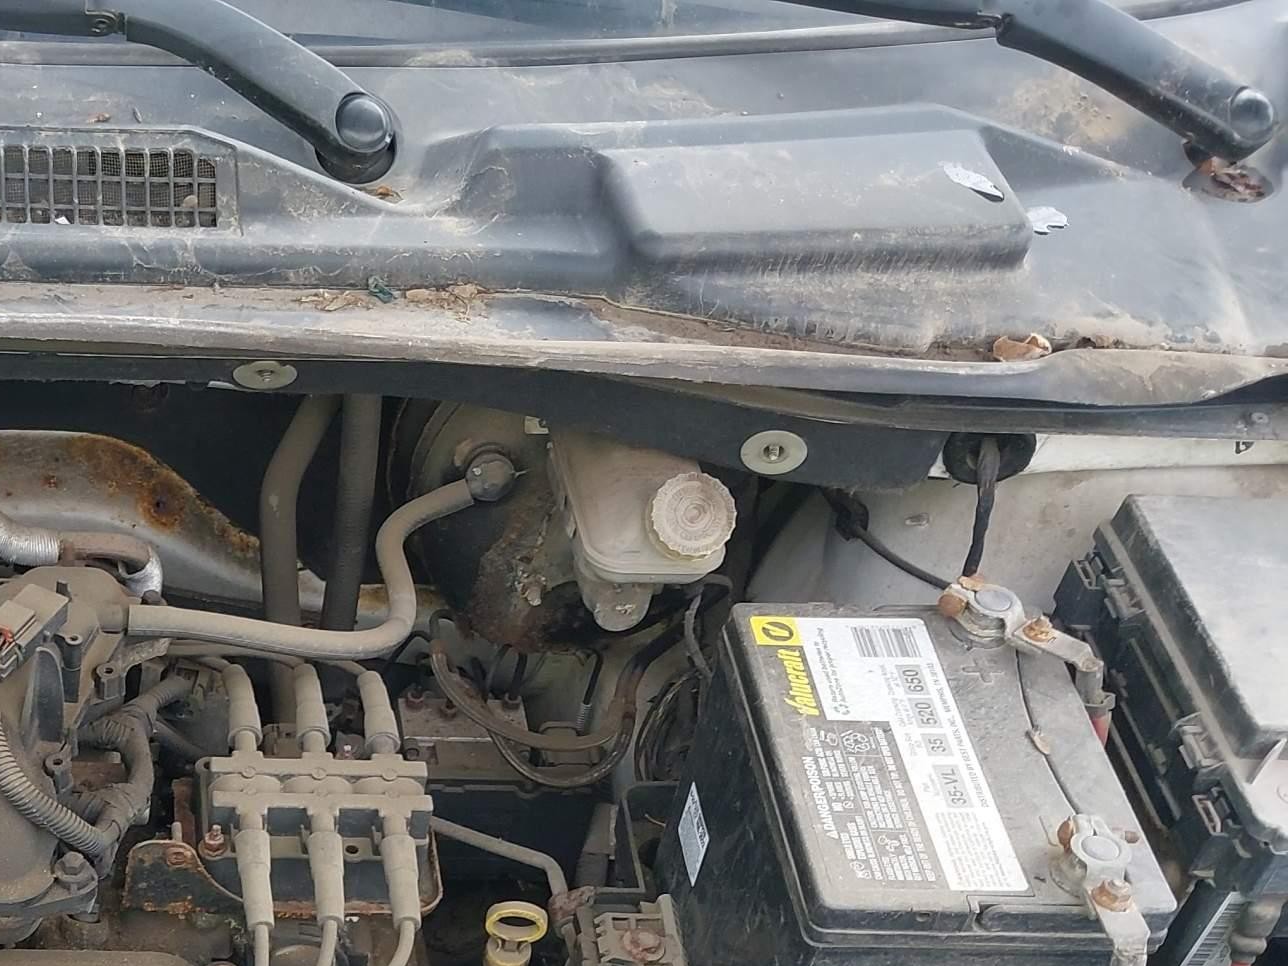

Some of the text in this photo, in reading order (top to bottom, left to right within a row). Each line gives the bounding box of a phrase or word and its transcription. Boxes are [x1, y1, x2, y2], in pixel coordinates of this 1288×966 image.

[778, 648, 821, 717] Valucraft
[902, 669, 924, 692] 650
[914, 702, 937, 724] 520
[927, 738, 946, 751] 35
[939, 767, 965, 804] 35-VL
